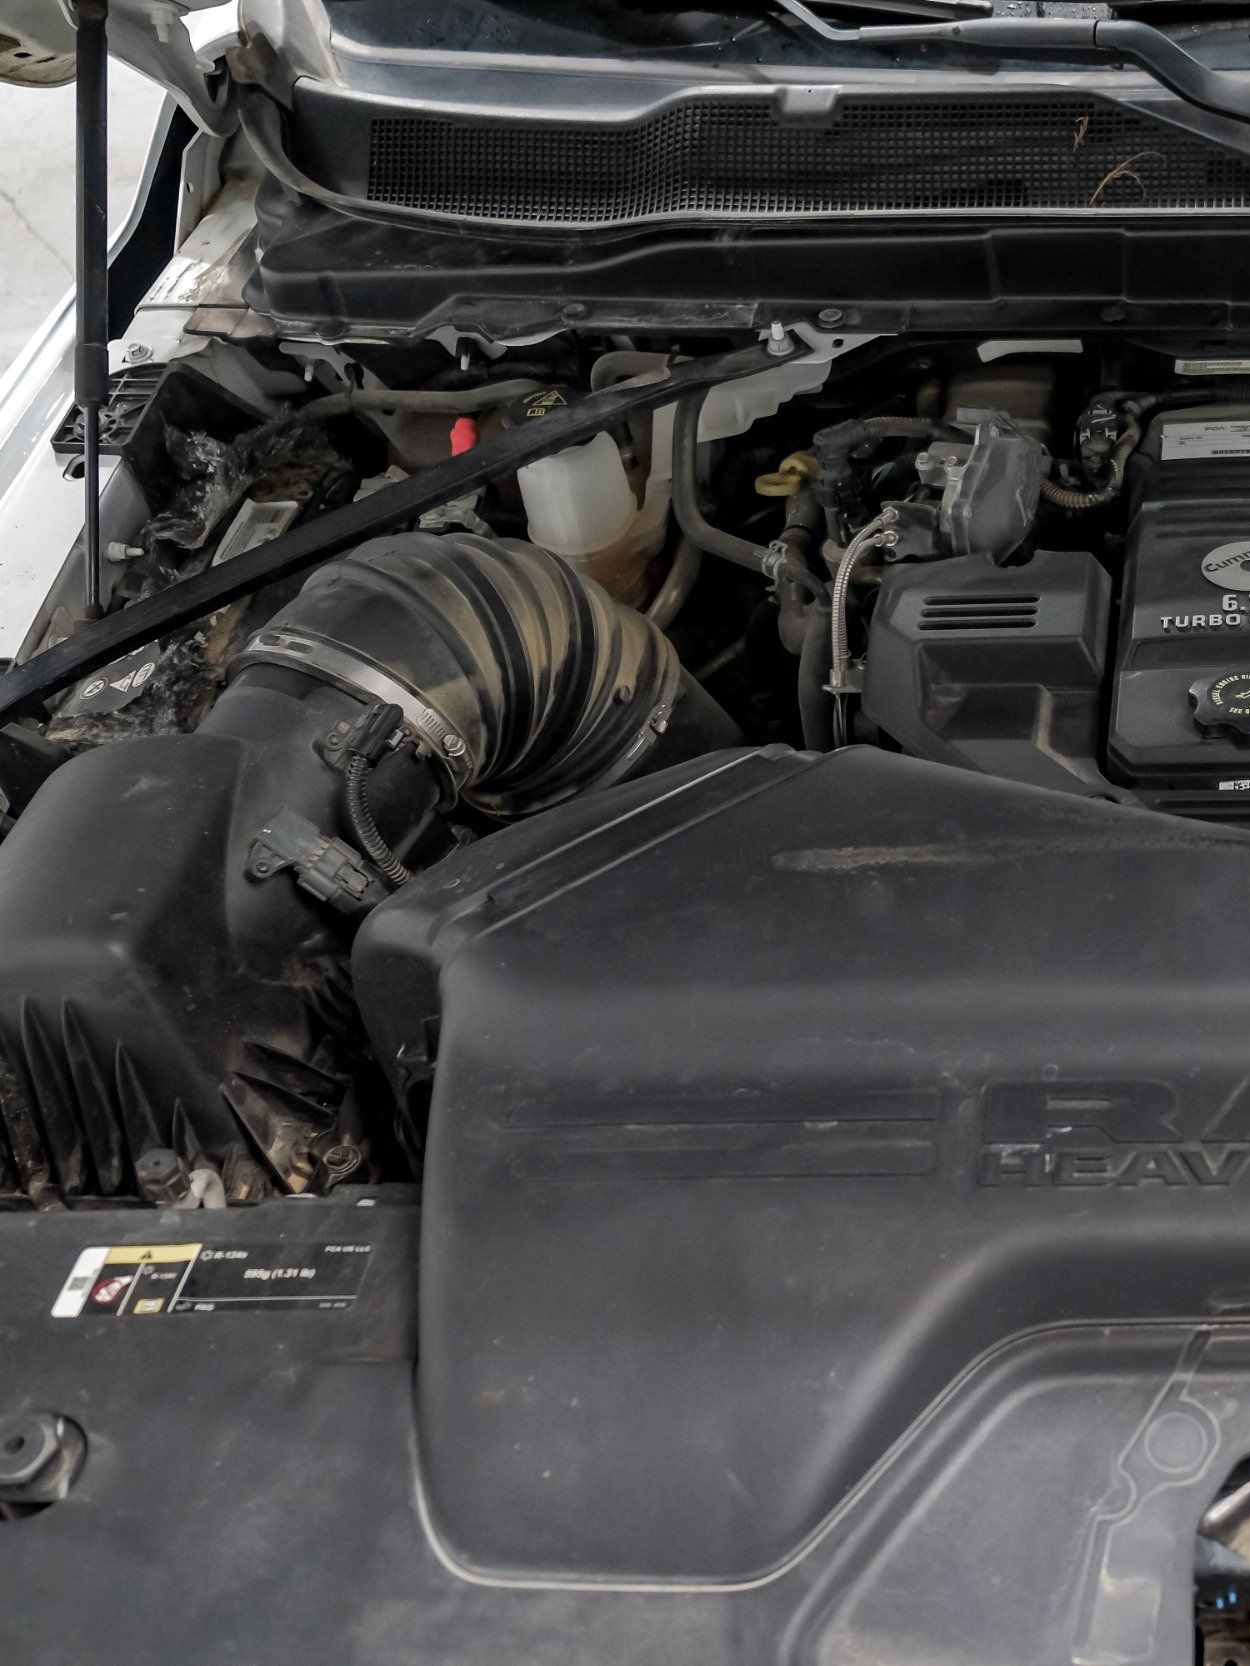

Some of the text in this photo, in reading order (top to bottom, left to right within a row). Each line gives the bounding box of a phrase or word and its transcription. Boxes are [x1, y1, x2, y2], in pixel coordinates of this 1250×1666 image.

[1160, 613, 1242, 630] TURBO
[1228, 706, 1244, 714] SEE
[271, 1268, 299, 1280] (1.31
